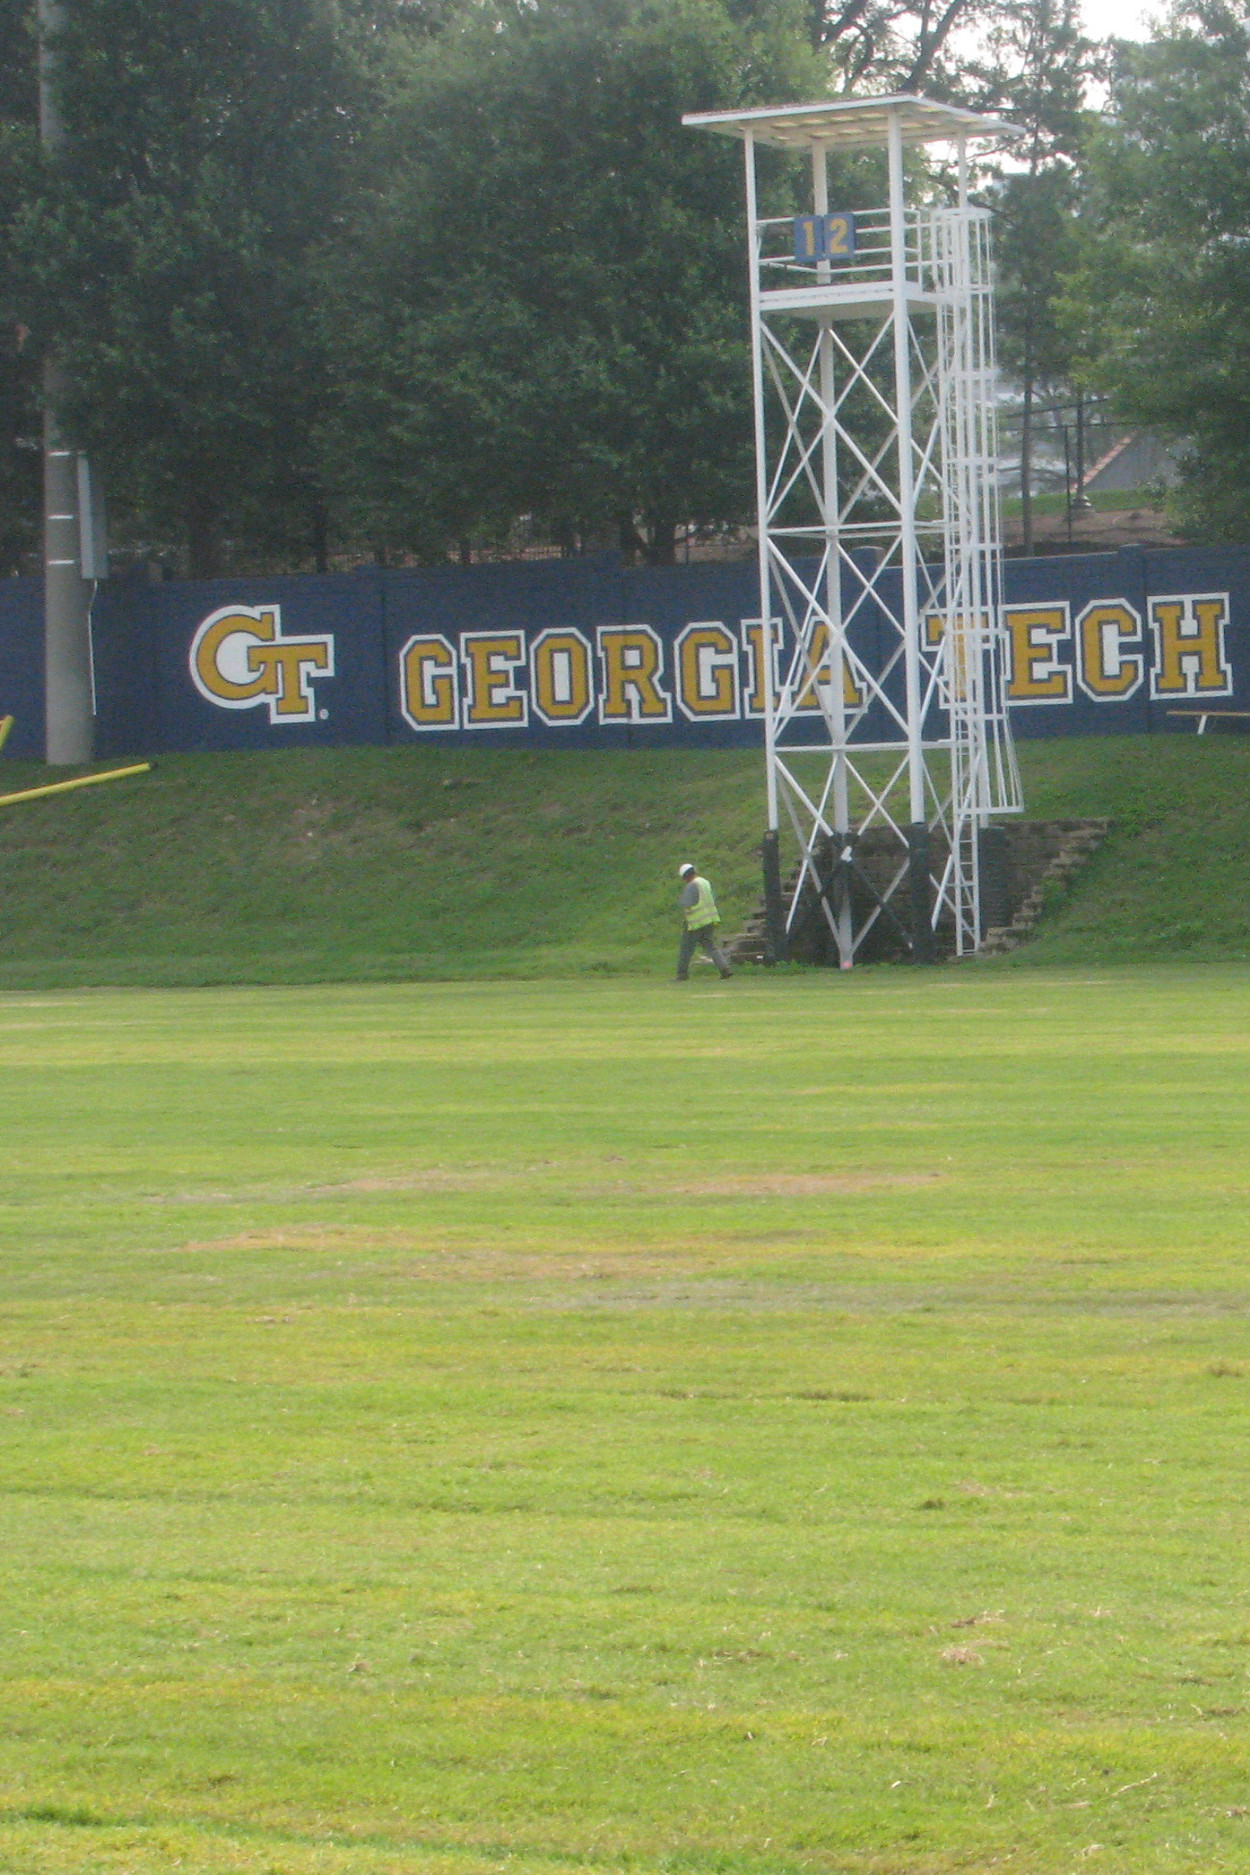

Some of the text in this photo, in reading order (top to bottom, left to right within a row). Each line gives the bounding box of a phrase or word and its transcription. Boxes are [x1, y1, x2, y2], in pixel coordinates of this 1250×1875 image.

[802, 217, 849, 256] 12
[189, 604, 335, 725] GT
[400, 615, 868, 731] GEORGIA
